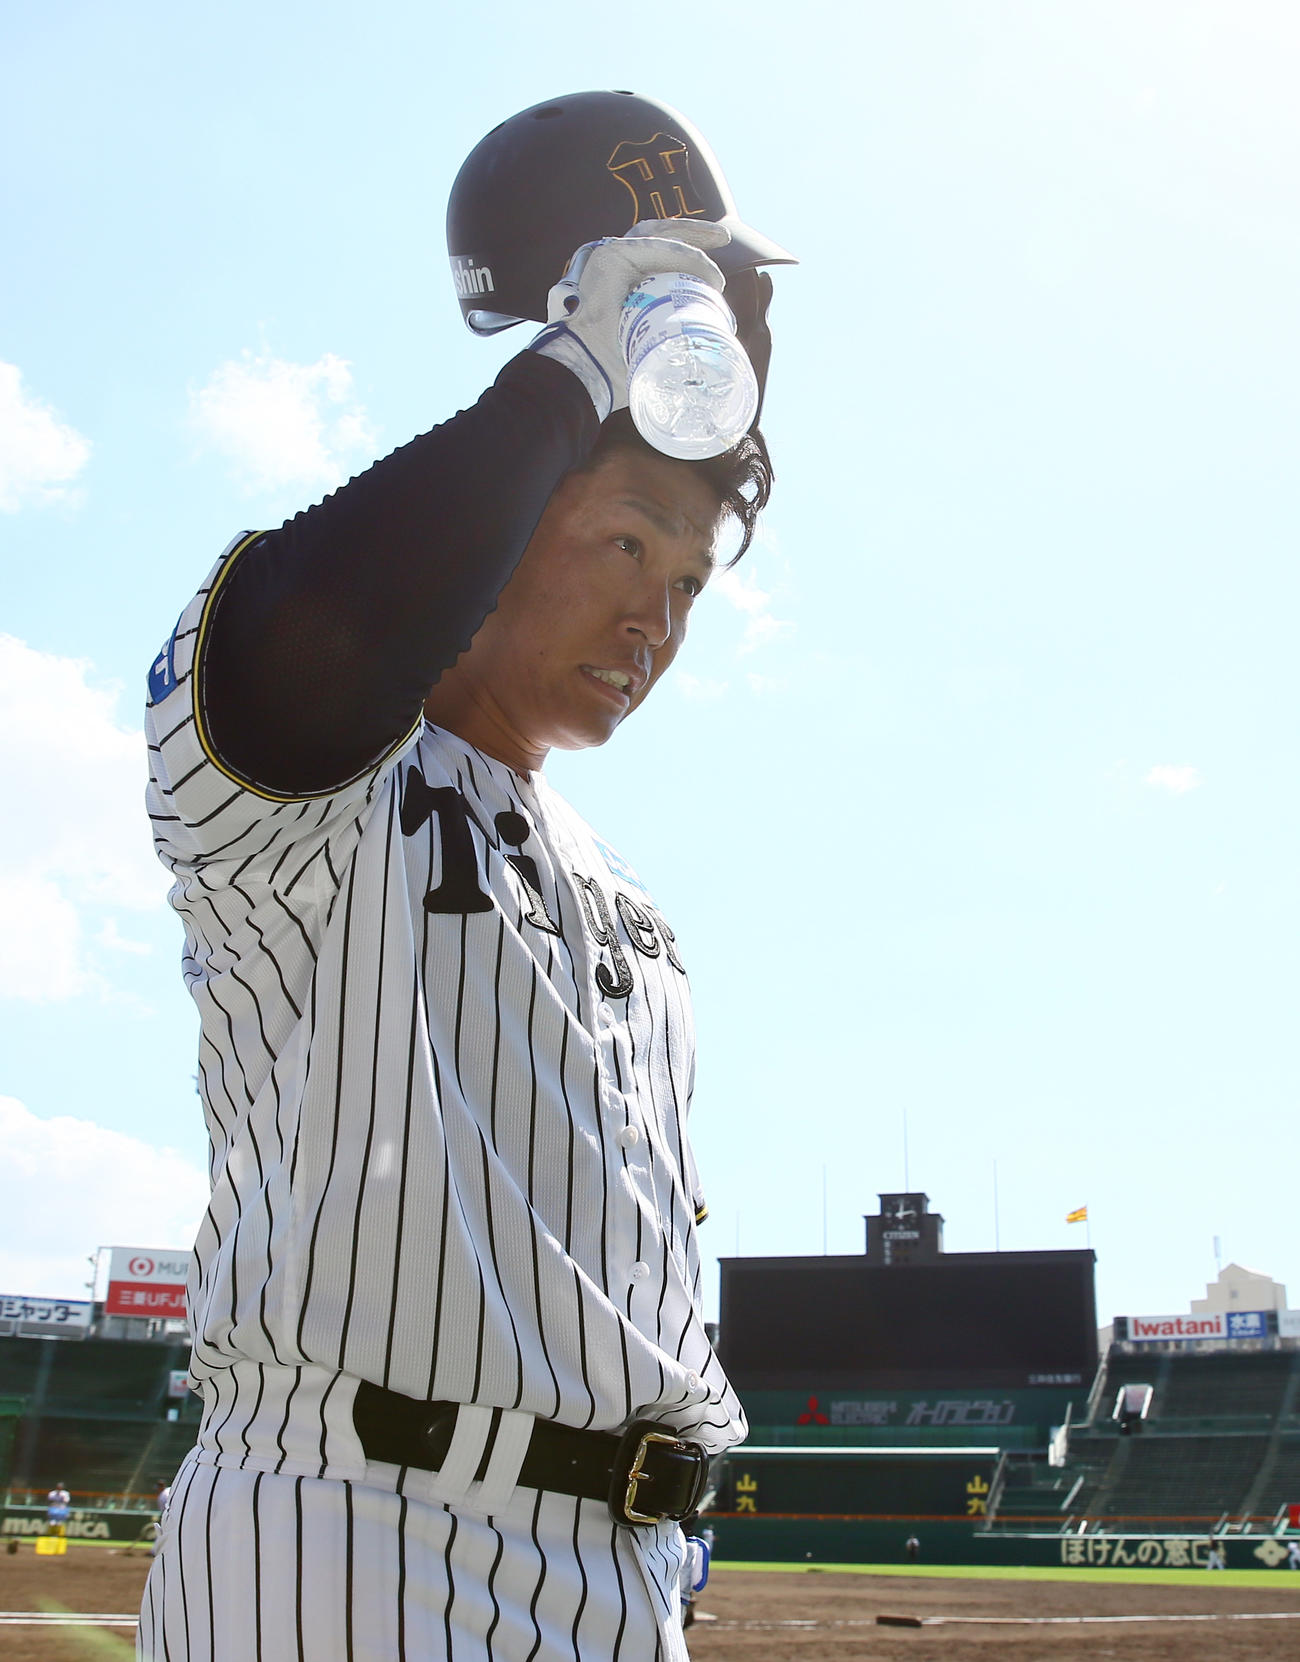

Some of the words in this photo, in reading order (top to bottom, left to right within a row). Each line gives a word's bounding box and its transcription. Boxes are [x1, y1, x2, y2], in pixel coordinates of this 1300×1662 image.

[0, 1300, 82, 1322] シャッター
[1133, 1316, 1222, 1336] Iwatani
[736, 1473, 758, 1513] 山九
[1061, 1539, 1227, 1567] ほけんの窓口
